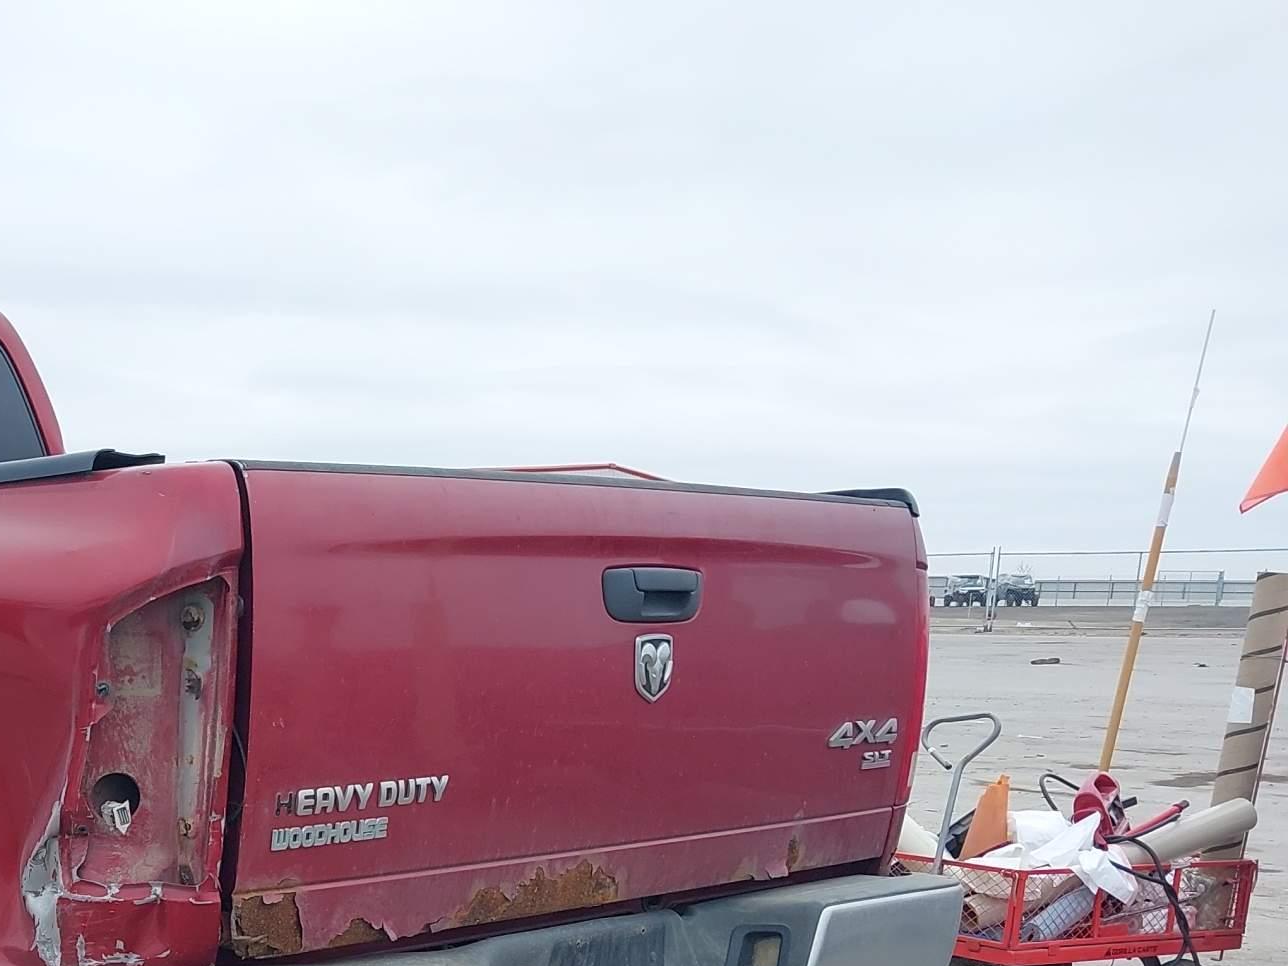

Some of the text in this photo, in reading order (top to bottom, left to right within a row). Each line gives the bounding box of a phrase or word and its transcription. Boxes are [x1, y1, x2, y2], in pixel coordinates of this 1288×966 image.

[828, 717, 898, 749] 4X4
[861, 749, 892, 764] SLT
[275, 774, 449, 818] HEAVY DUTY
[270, 816, 389, 852] WOODHOUSE
